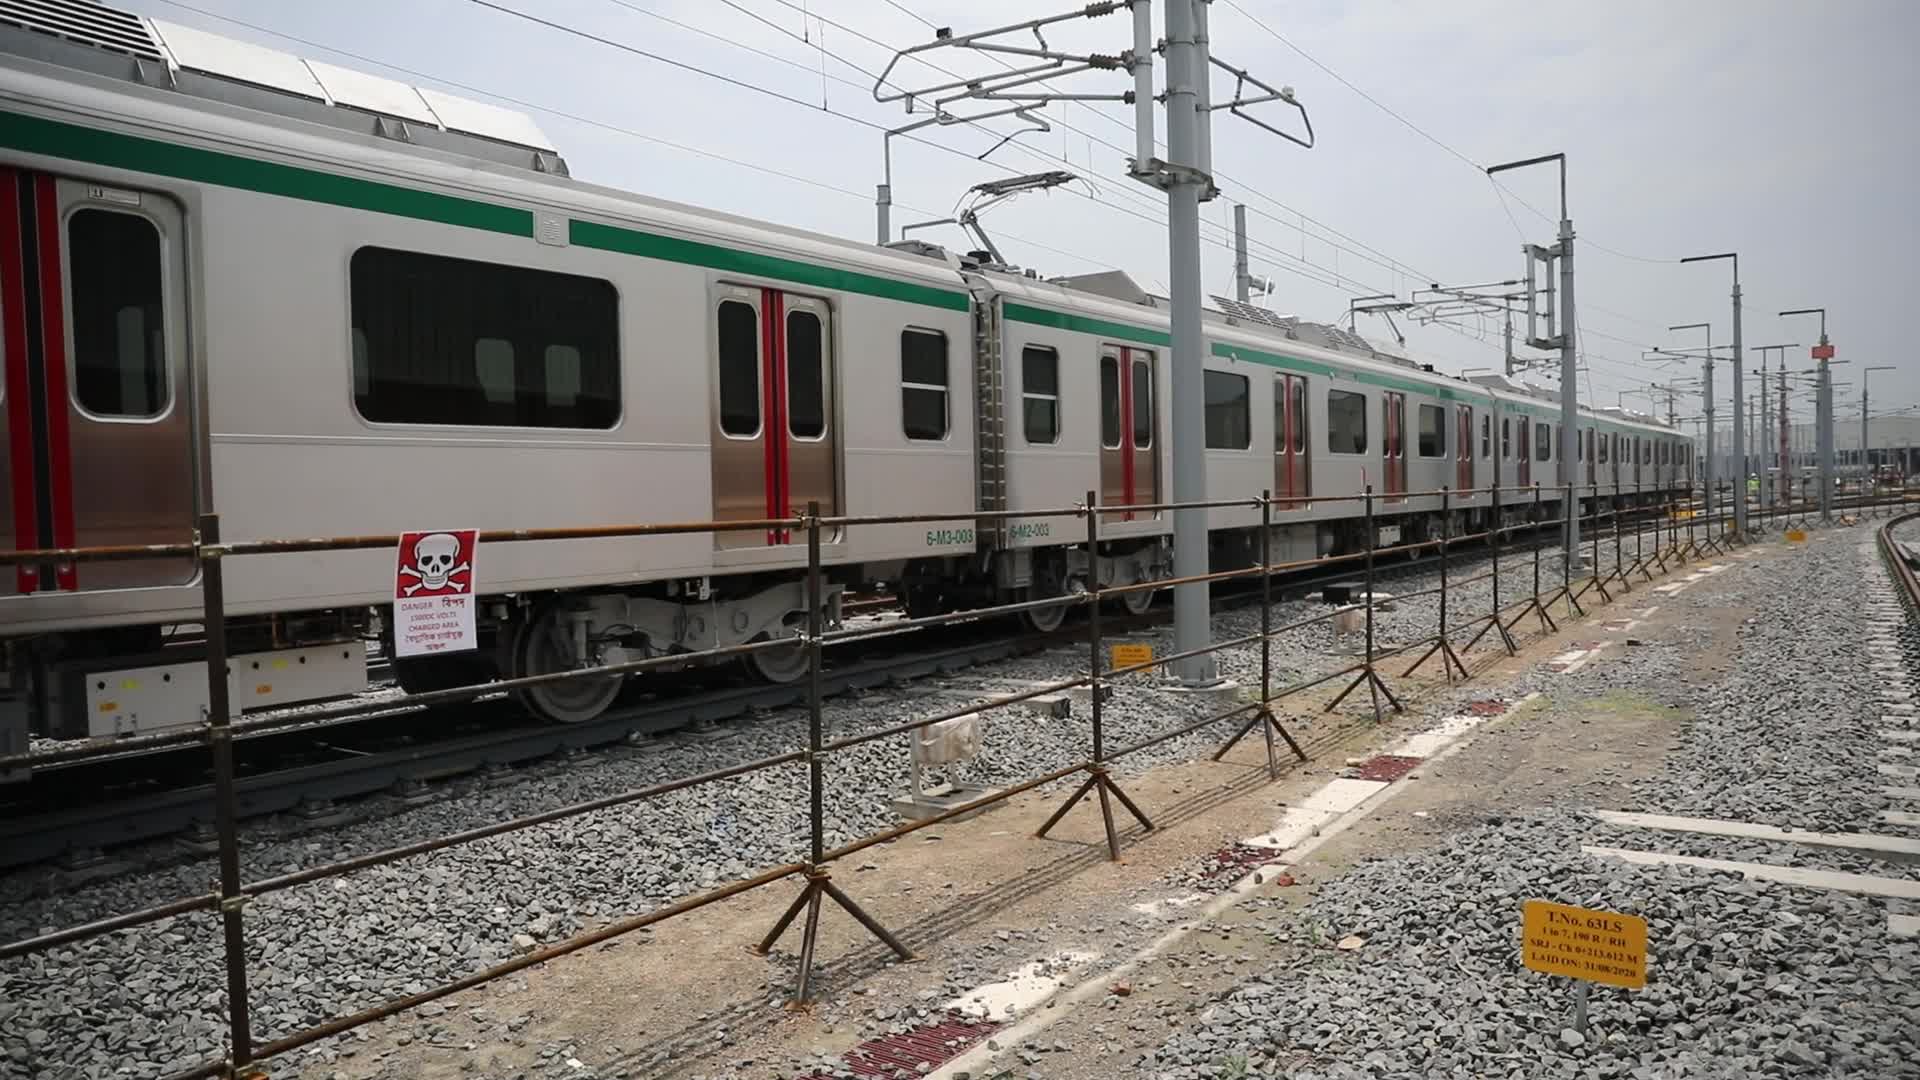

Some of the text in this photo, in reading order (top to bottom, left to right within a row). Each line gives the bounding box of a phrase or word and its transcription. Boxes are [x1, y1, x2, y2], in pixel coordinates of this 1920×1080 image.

[926, 528, 974, 546] 6-M3-003
[1009, 523, 1050, 539] 6-M2-003
[401, 602, 433, 611] DANGER
[1546, 910, 1623, 933] T.No. 63LS
[1530, 938, 1550, 949] SRJ
[1559, 943, 1573, 953] Ch
[1609, 937, 1626, 948] RH
[1531, 952, 1559, 964] LAID
